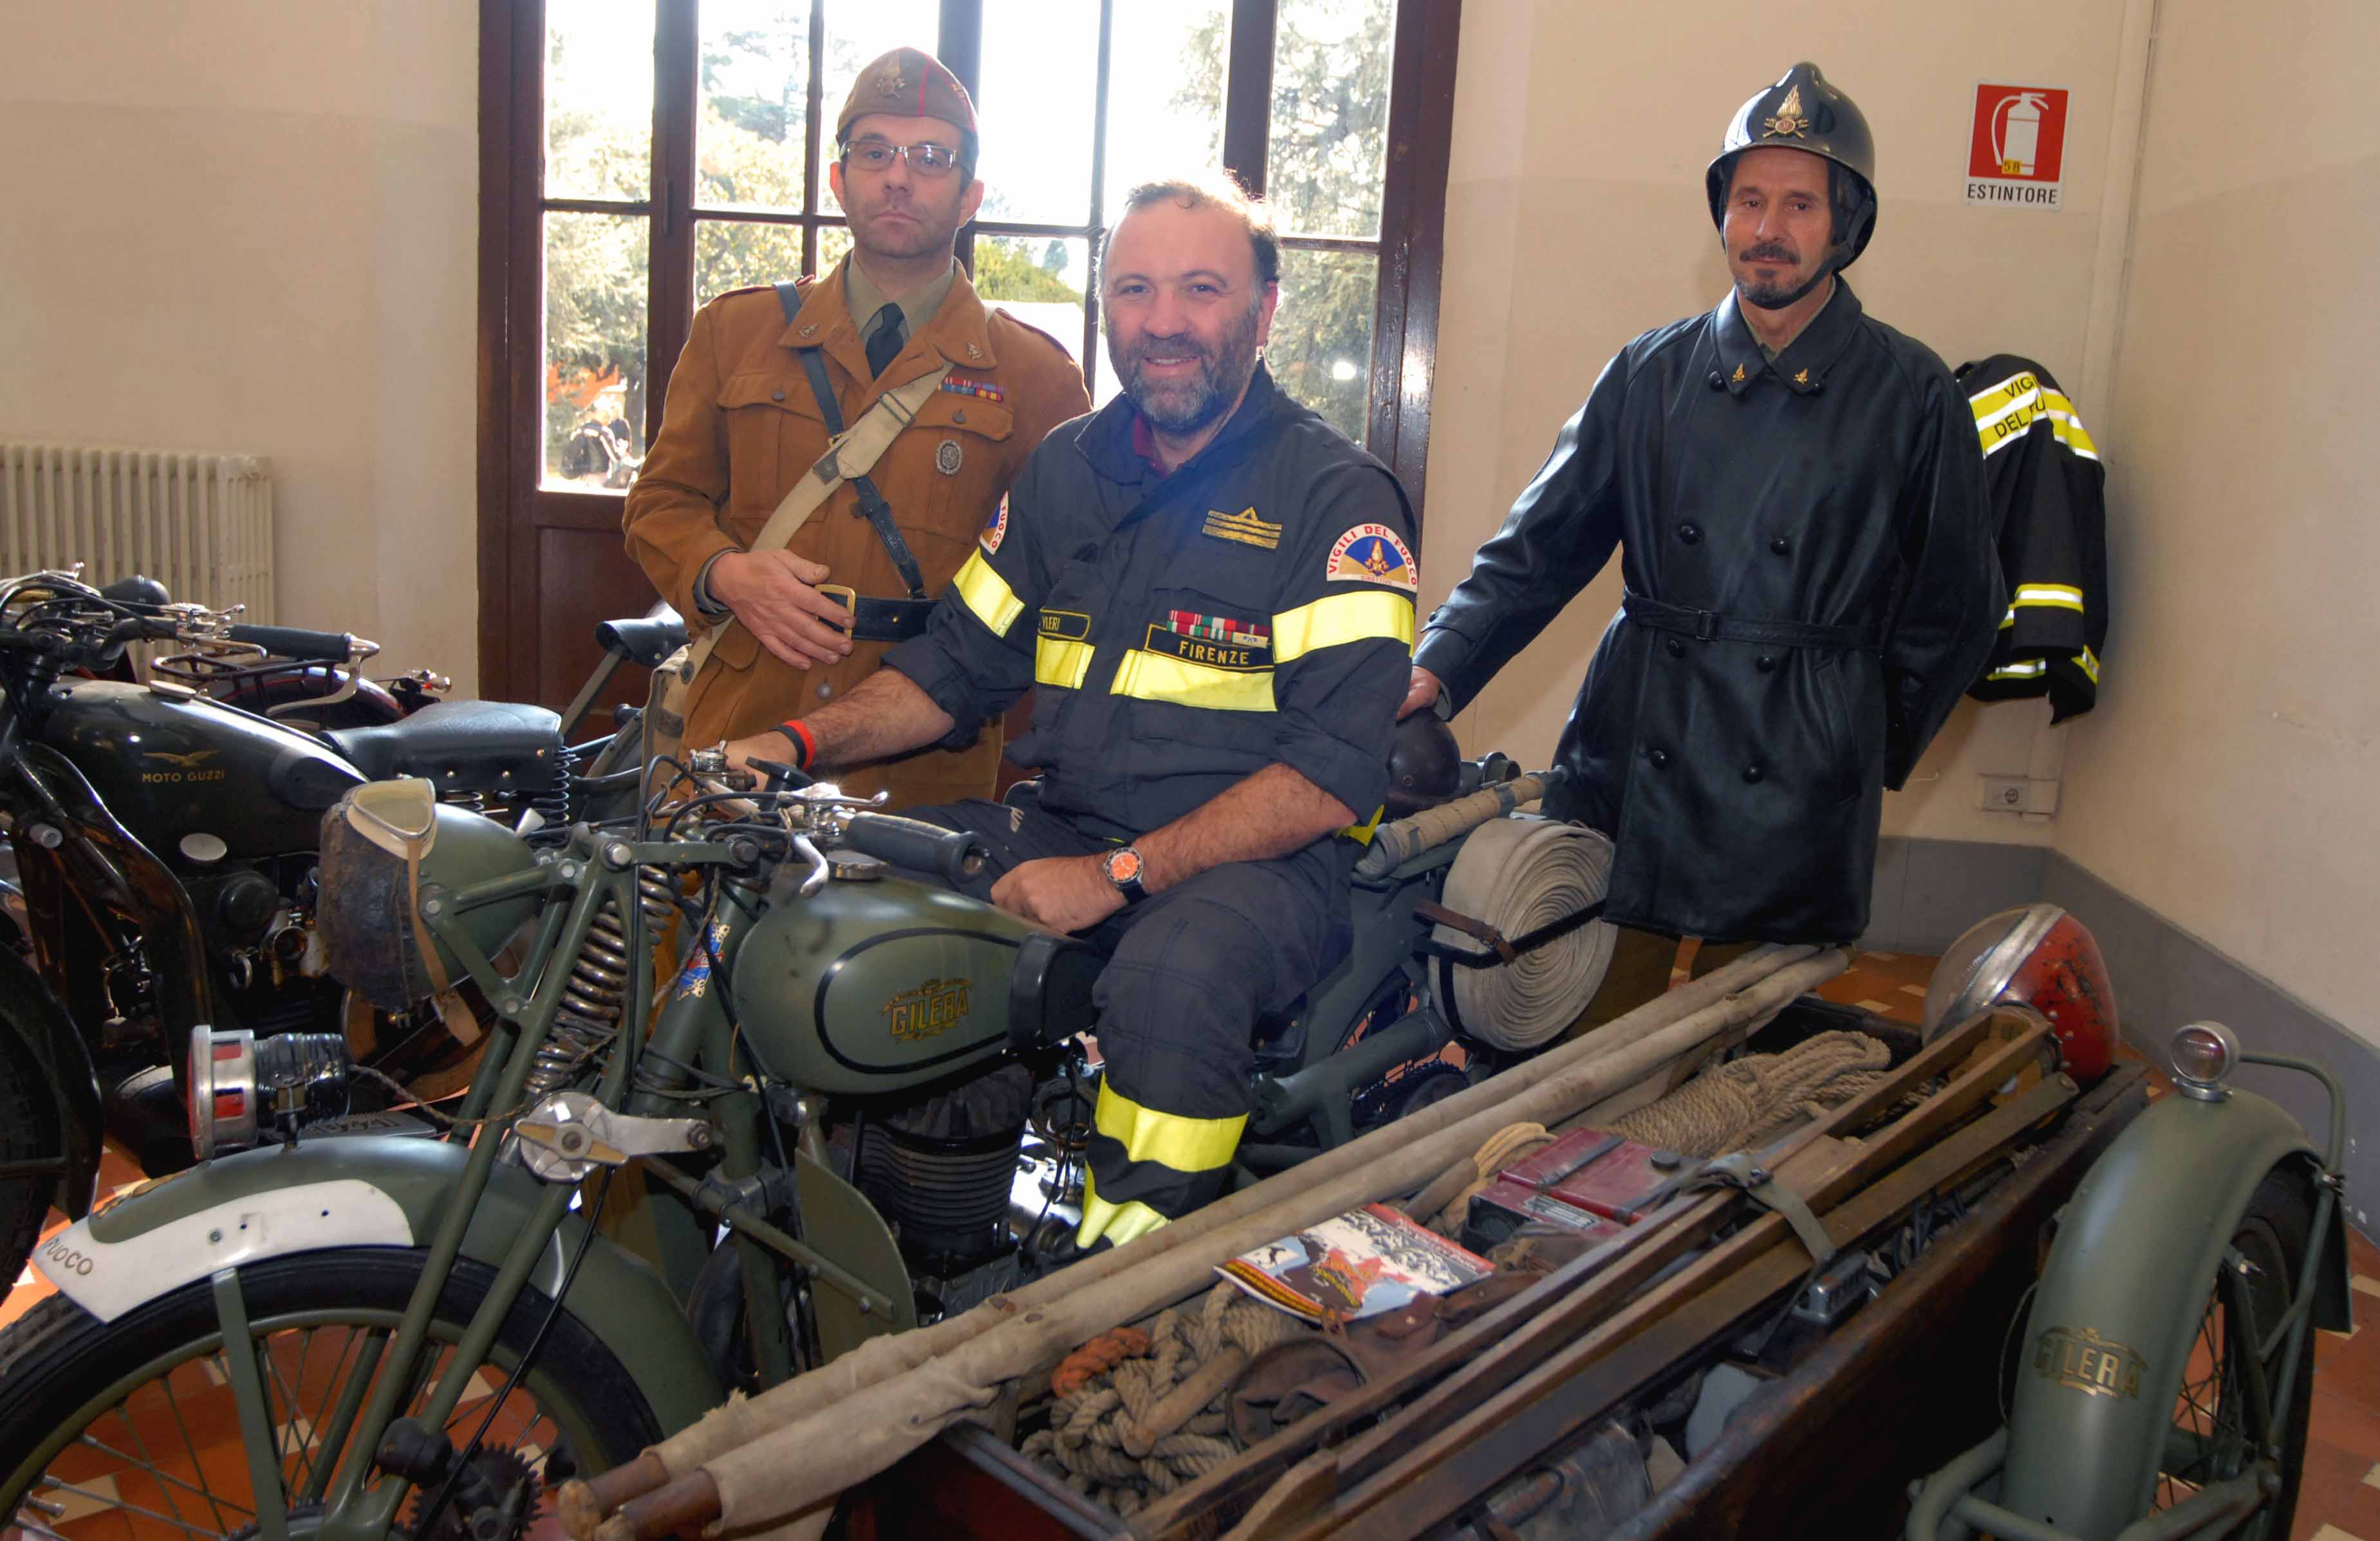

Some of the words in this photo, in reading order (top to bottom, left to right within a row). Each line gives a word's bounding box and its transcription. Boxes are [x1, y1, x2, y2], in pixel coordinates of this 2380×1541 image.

[1967, 183, 2058, 204] ESTINTORE
[1994, 414, 2029, 438] DEL
[1328, 530, 1358, 574] VIGILI
[1364, 525, 1389, 539] DEL
[1393, 539, 1417, 586] FUOCO
[1178, 640, 1250, 666] FIRENZE
[142, 772, 183, 783] MOTO
[187, 769, 225, 781] GUZZI
[889, 987, 969, 1036] GILERA
